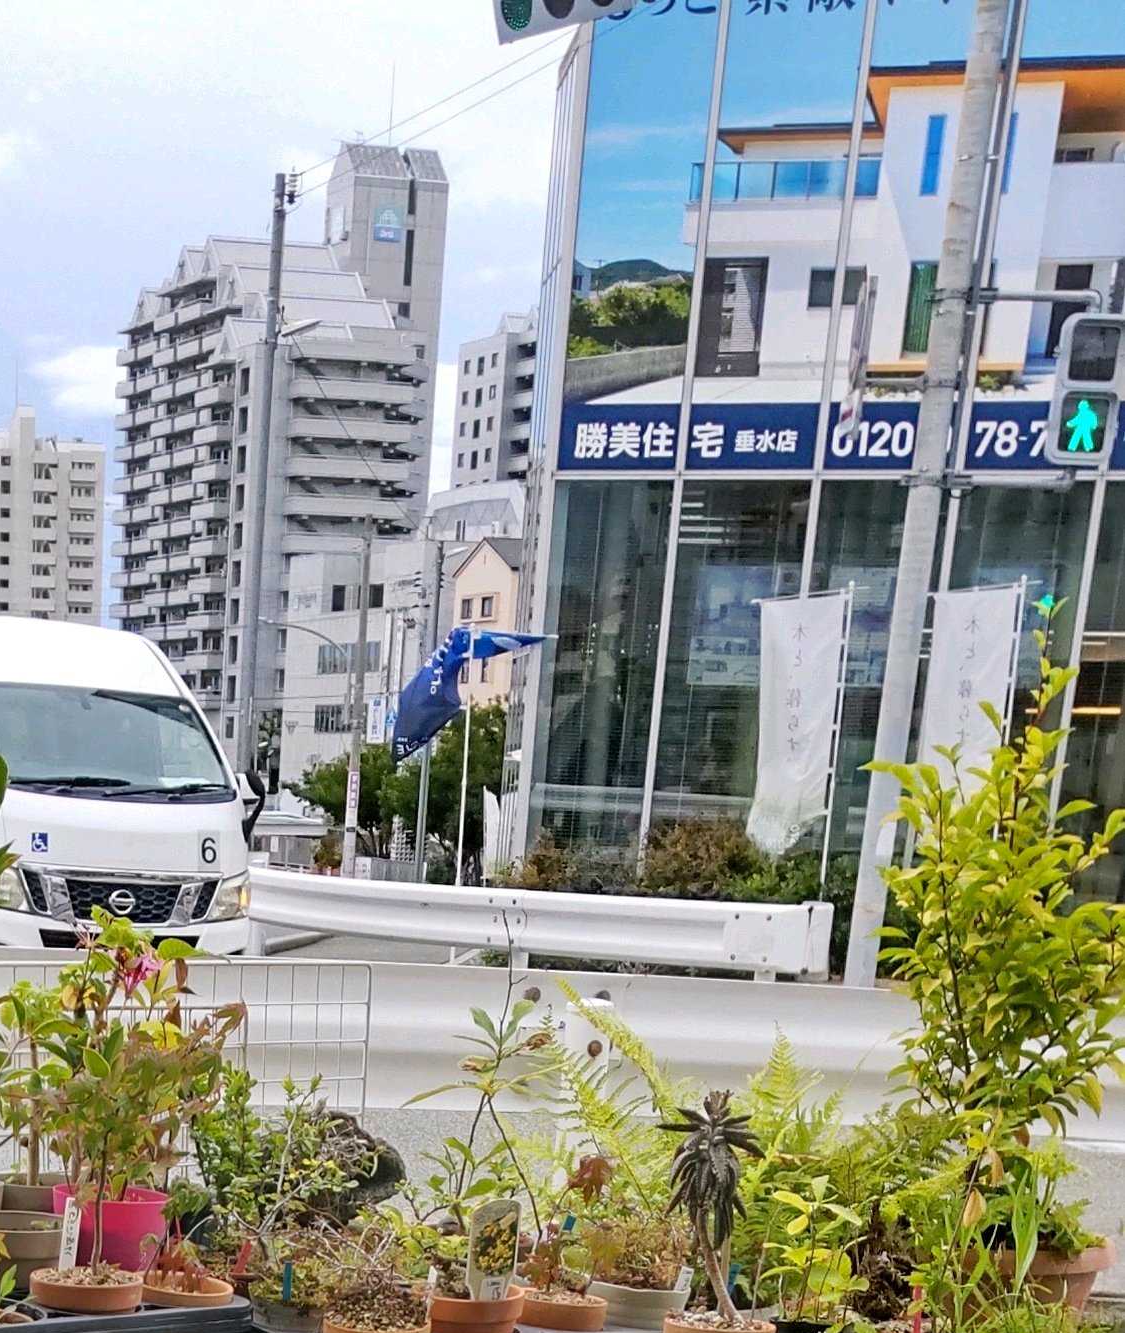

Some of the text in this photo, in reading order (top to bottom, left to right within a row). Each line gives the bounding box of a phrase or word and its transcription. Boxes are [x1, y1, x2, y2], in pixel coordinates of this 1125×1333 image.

[573, 421, 725, 459] 勝美住宅
[733, 429, 799, 453] 垂水店
[201, 836, 217, 864] 6
